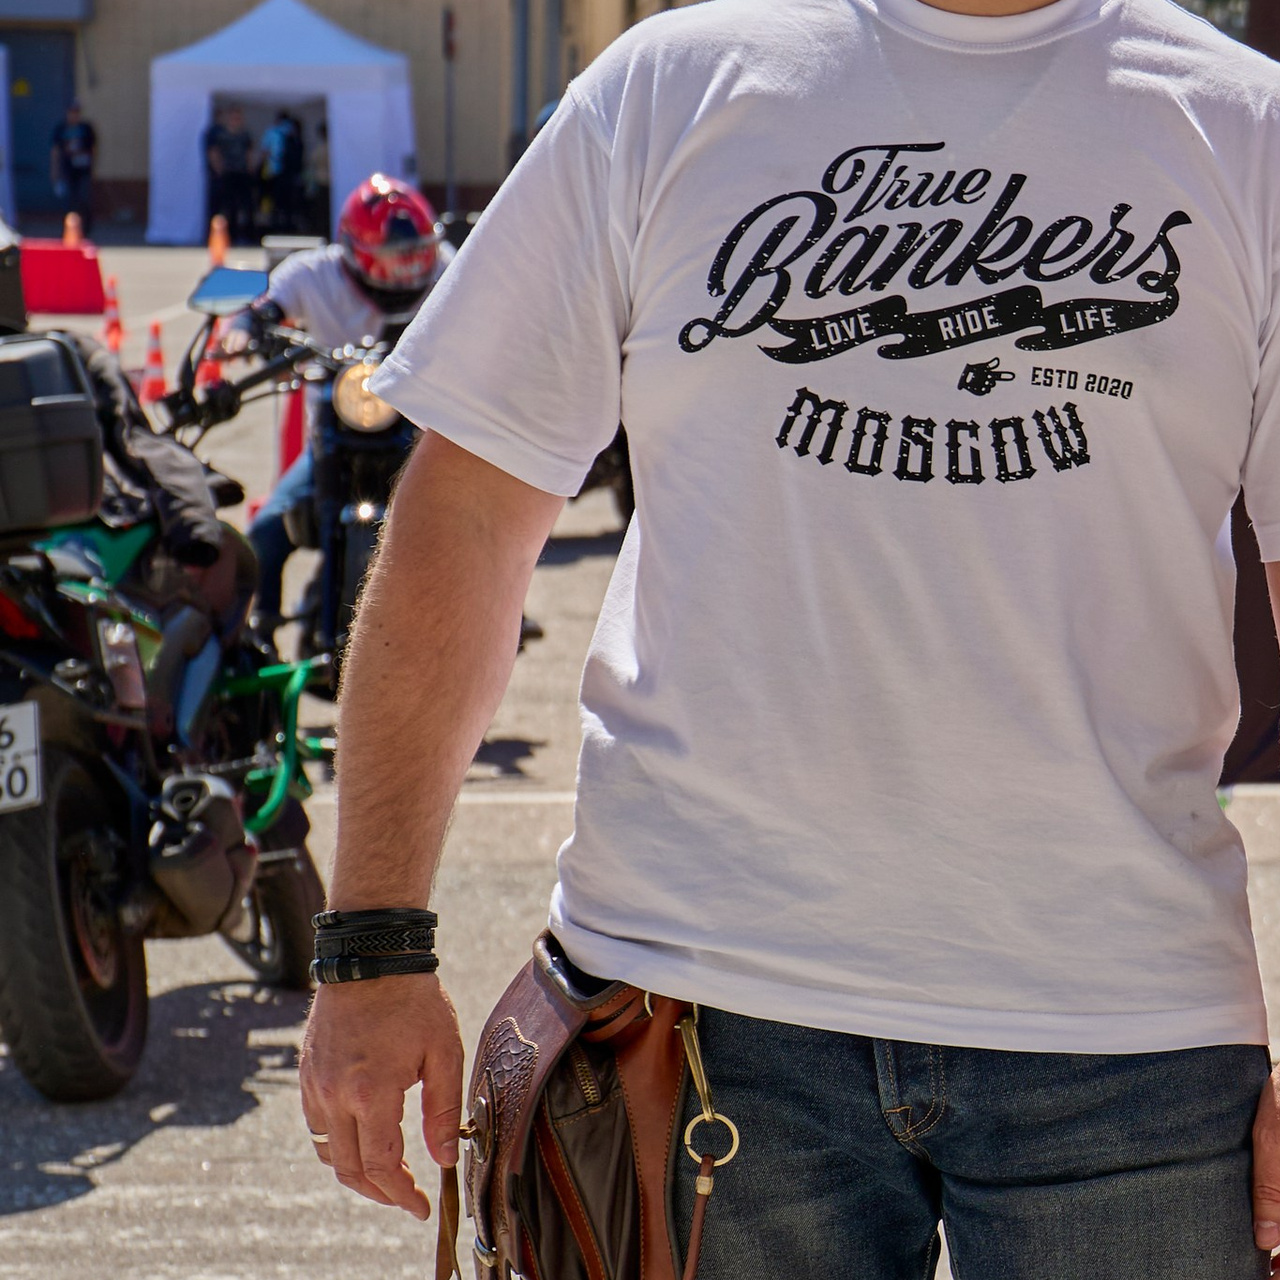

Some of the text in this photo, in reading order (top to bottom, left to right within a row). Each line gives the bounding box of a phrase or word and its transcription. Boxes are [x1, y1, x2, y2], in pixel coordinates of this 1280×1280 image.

[821, 141, 992, 223] True
[678, 173, 1193, 353] Bankers
[810, 305, 1118, 350] LOVE RIDE LIFE
[1031, 366, 1134, 400] ESTD 2020
[774, 386, 1091, 486] MOSCOW
